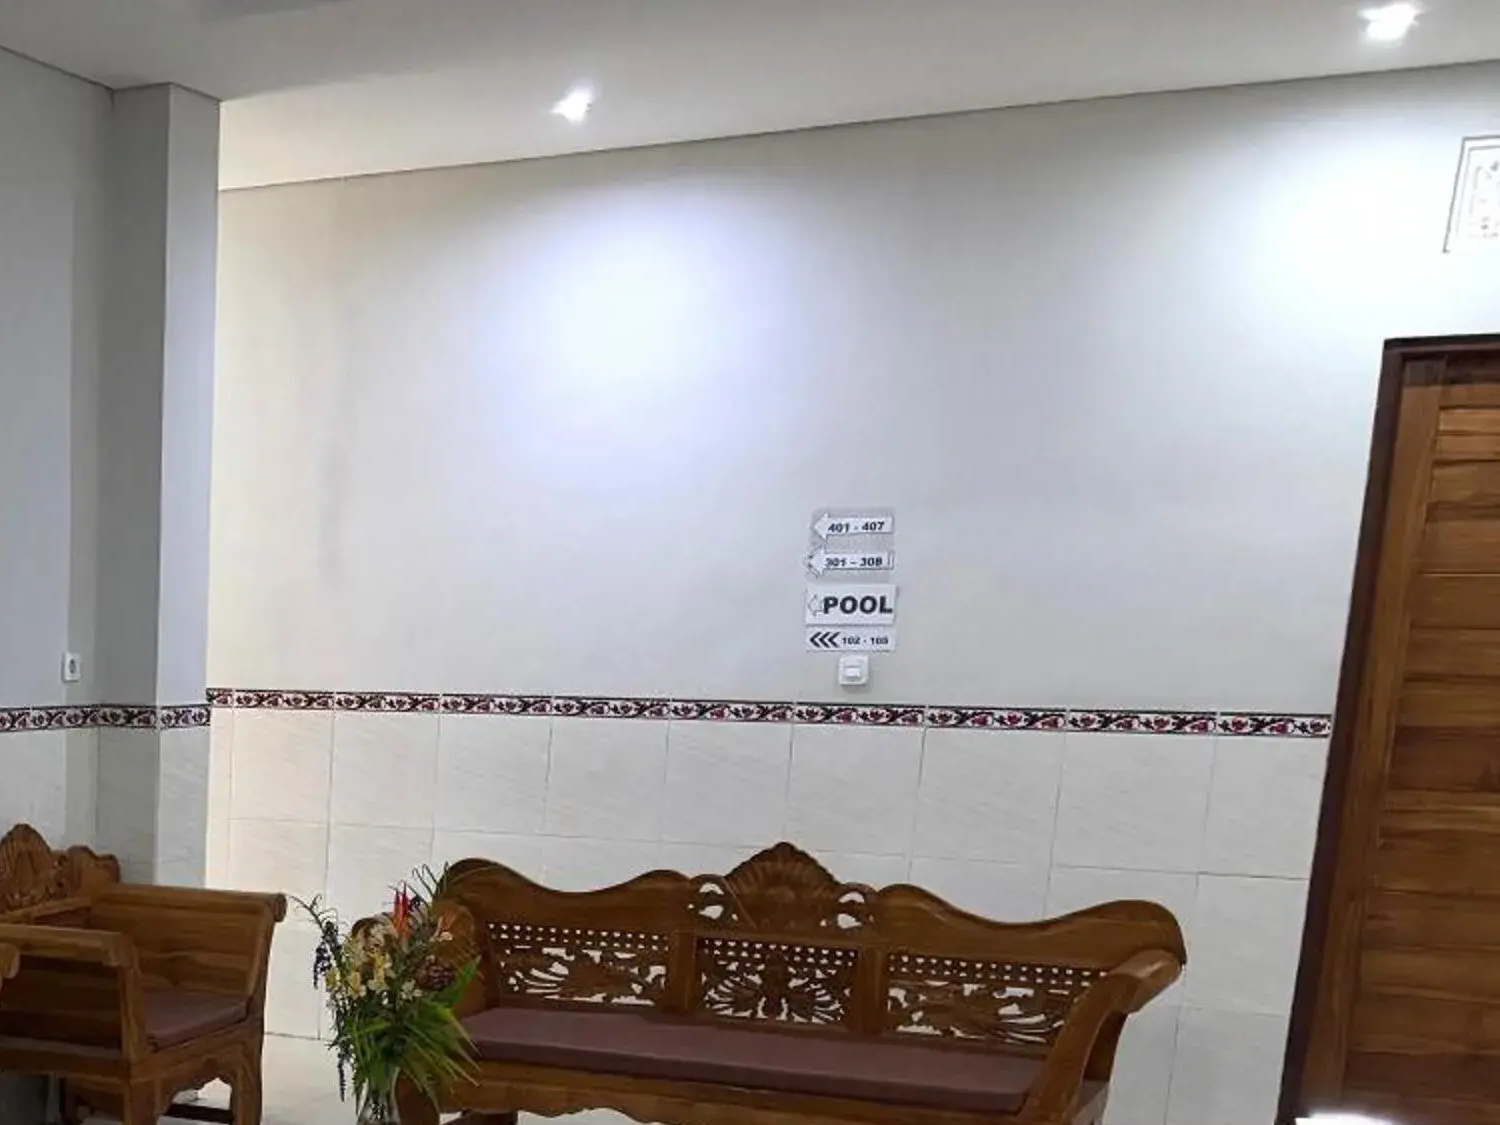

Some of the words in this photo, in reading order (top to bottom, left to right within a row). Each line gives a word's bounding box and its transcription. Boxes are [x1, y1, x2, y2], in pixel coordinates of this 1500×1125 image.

[827, 522, 850, 533] 401
[861, 520, 885, 531] 407
[823, 595, 893, 614] POOL
